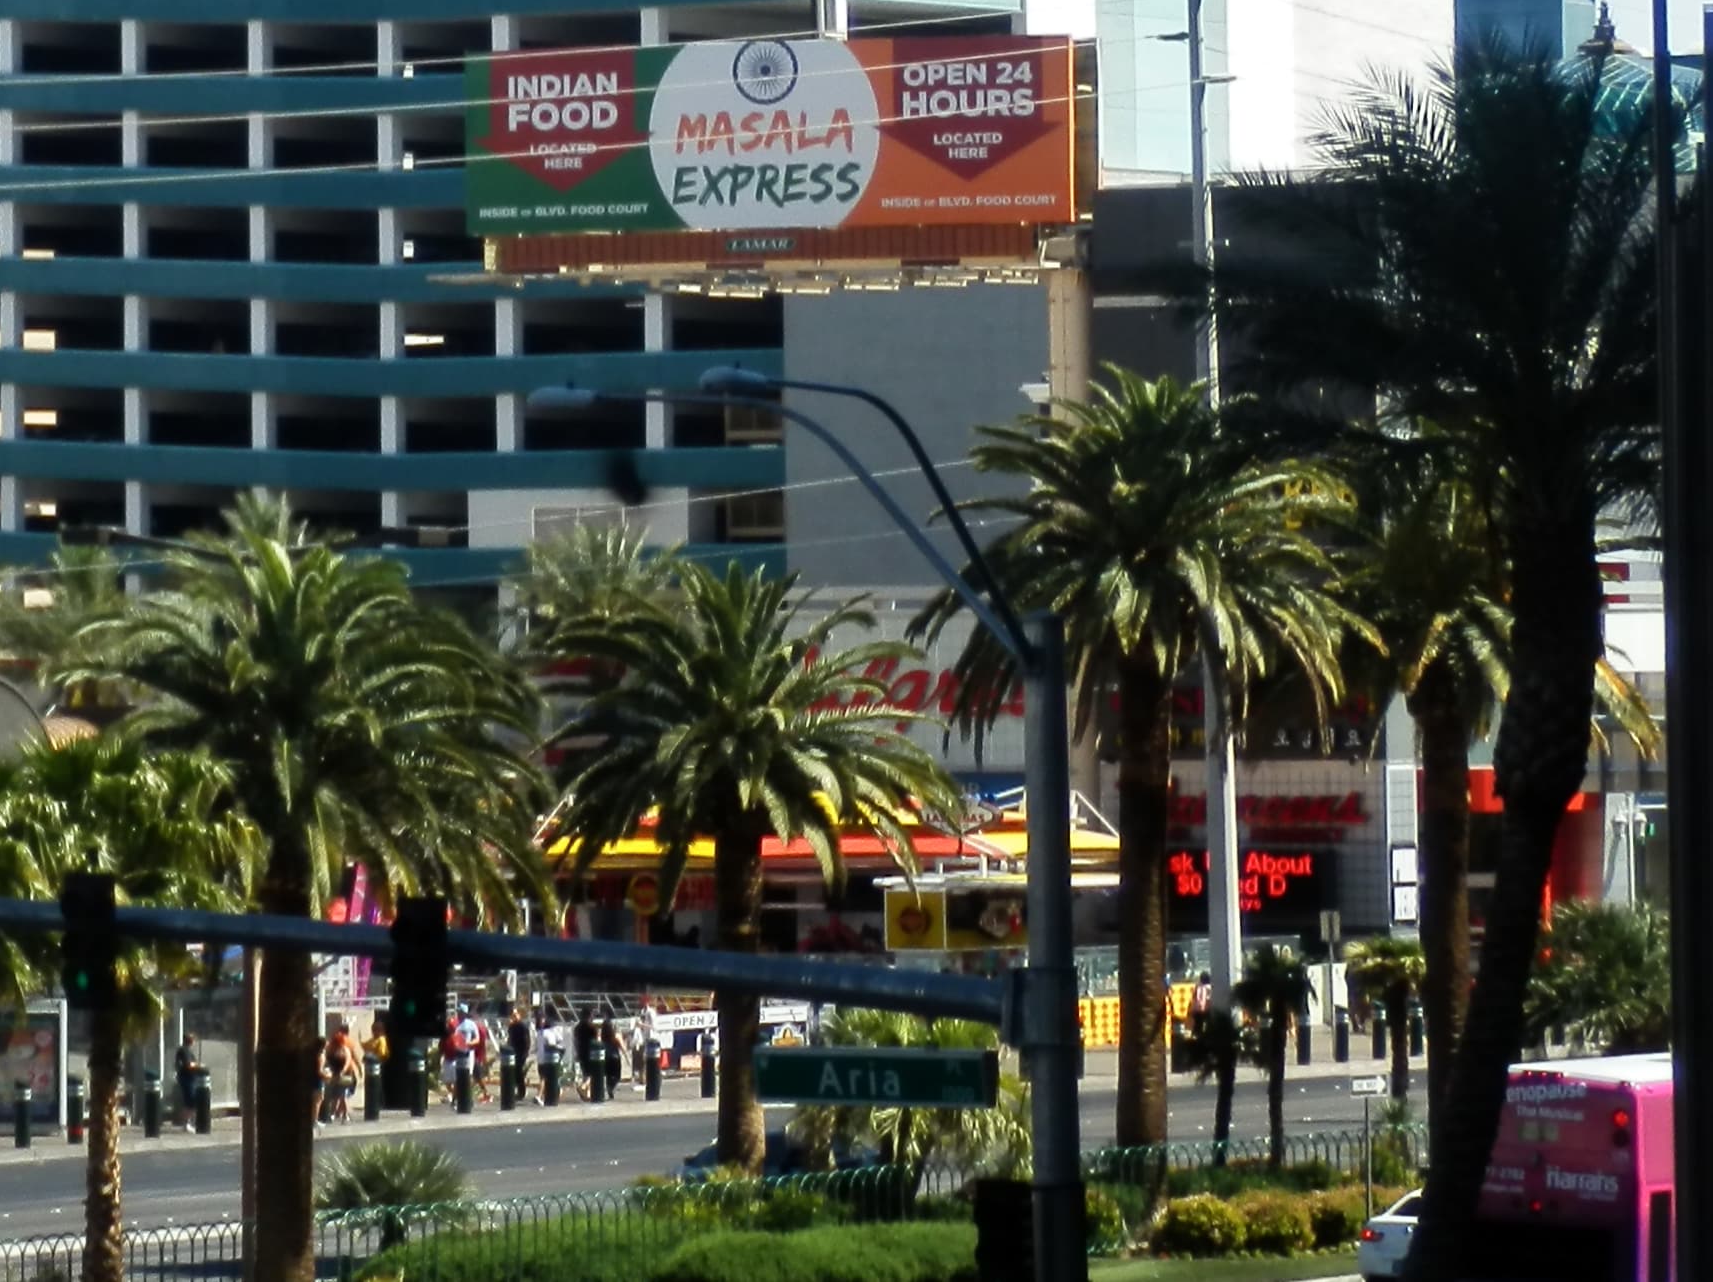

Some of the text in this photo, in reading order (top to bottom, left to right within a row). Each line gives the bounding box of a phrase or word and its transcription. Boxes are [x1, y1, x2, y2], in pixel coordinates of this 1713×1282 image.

[903, 61, 1033, 86] OPEN 24
[507, 72, 618, 100] INDIAN
[902, 88, 1035, 118] HOURS
[508, 100, 618, 132] FOOD
[675, 107, 854, 156] MASALA
[933, 132, 1003, 146] LOCATED
[529, 143, 598, 156] LOCATED
[948, 147, 989, 159] HERE
[544, 157, 583, 169] HERE
[672, 162, 861, 208] EXPRESS
[571, 204, 605, 215] FOOD
[608, 203, 649, 214] COURT
[881, 197, 921, 208] INSIDE
[976, 195, 1011, 206] FOOD
[1015, 194, 1057, 206] COURT
[1244, 851, 1312, 876] About
[674, 1013, 705, 1029] OPEN
[818, 1060, 902, 1097] Aria
[1506, 1084, 1587, 1103] enopause
